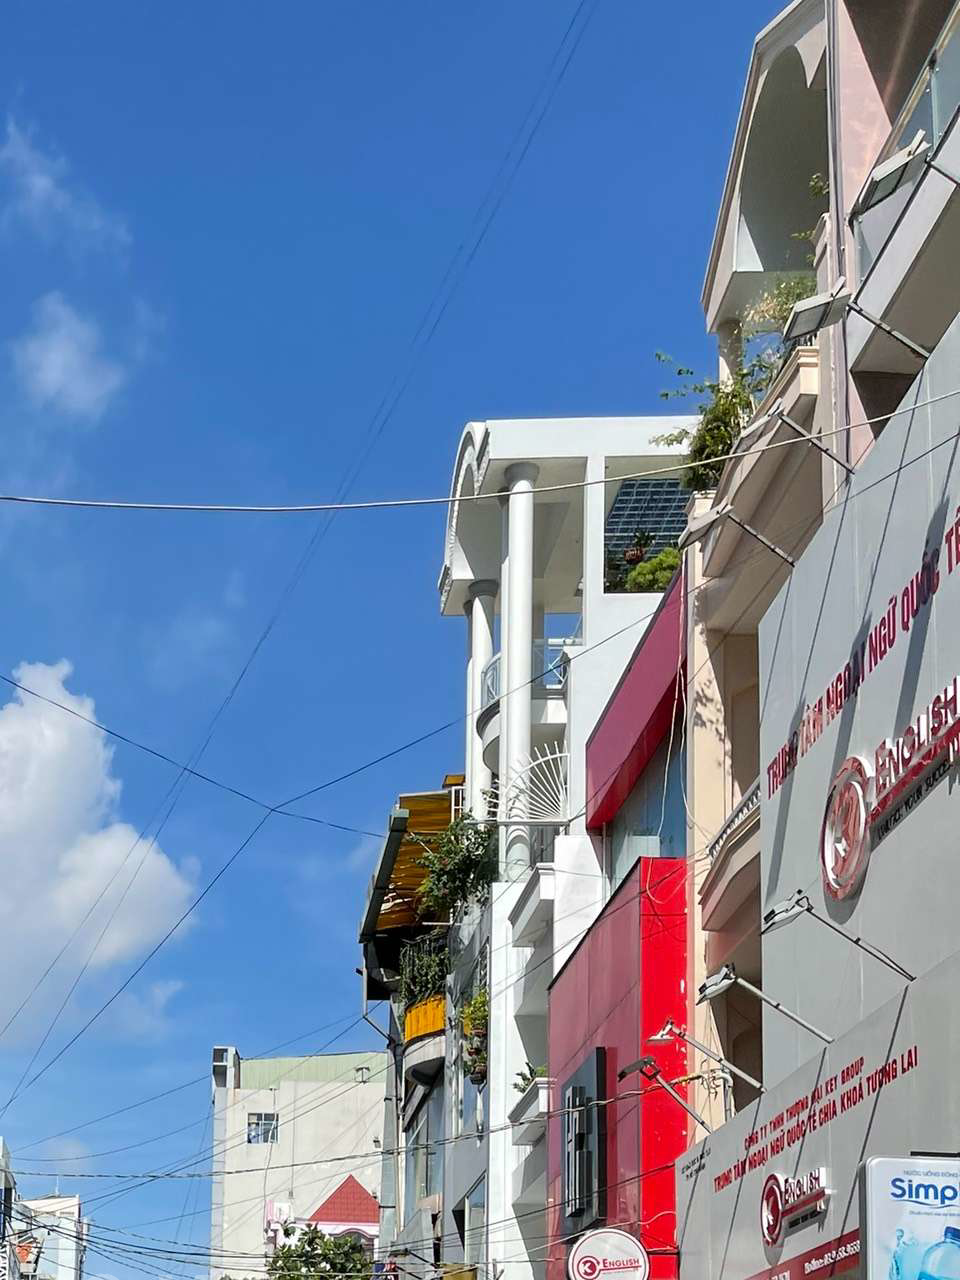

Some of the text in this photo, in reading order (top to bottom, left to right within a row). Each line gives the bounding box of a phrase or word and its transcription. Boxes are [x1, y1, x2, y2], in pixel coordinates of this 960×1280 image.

[768, 731, 799, 799] TRUNG
[800, 701, 824, 757] TÂM
[827, 645, 866, 727] NGOẠI
[868, 595, 897, 674] NGỮ
[902, 549, 940, 630] QUỐC
[875, 677, 958, 799] ENGLISH
[825, 1073, 838, 1095] KEY
[841, 1056, 864, 1085] GROUP
[713, 1170, 732, 1192] TRUNG
[747, 1147, 769, 1171] NGOẠI
[901, 1046, 918, 1074] LAI
[891, 1178, 959, 1205] Simp
[603, 1258, 640, 1267] ENGLISH
